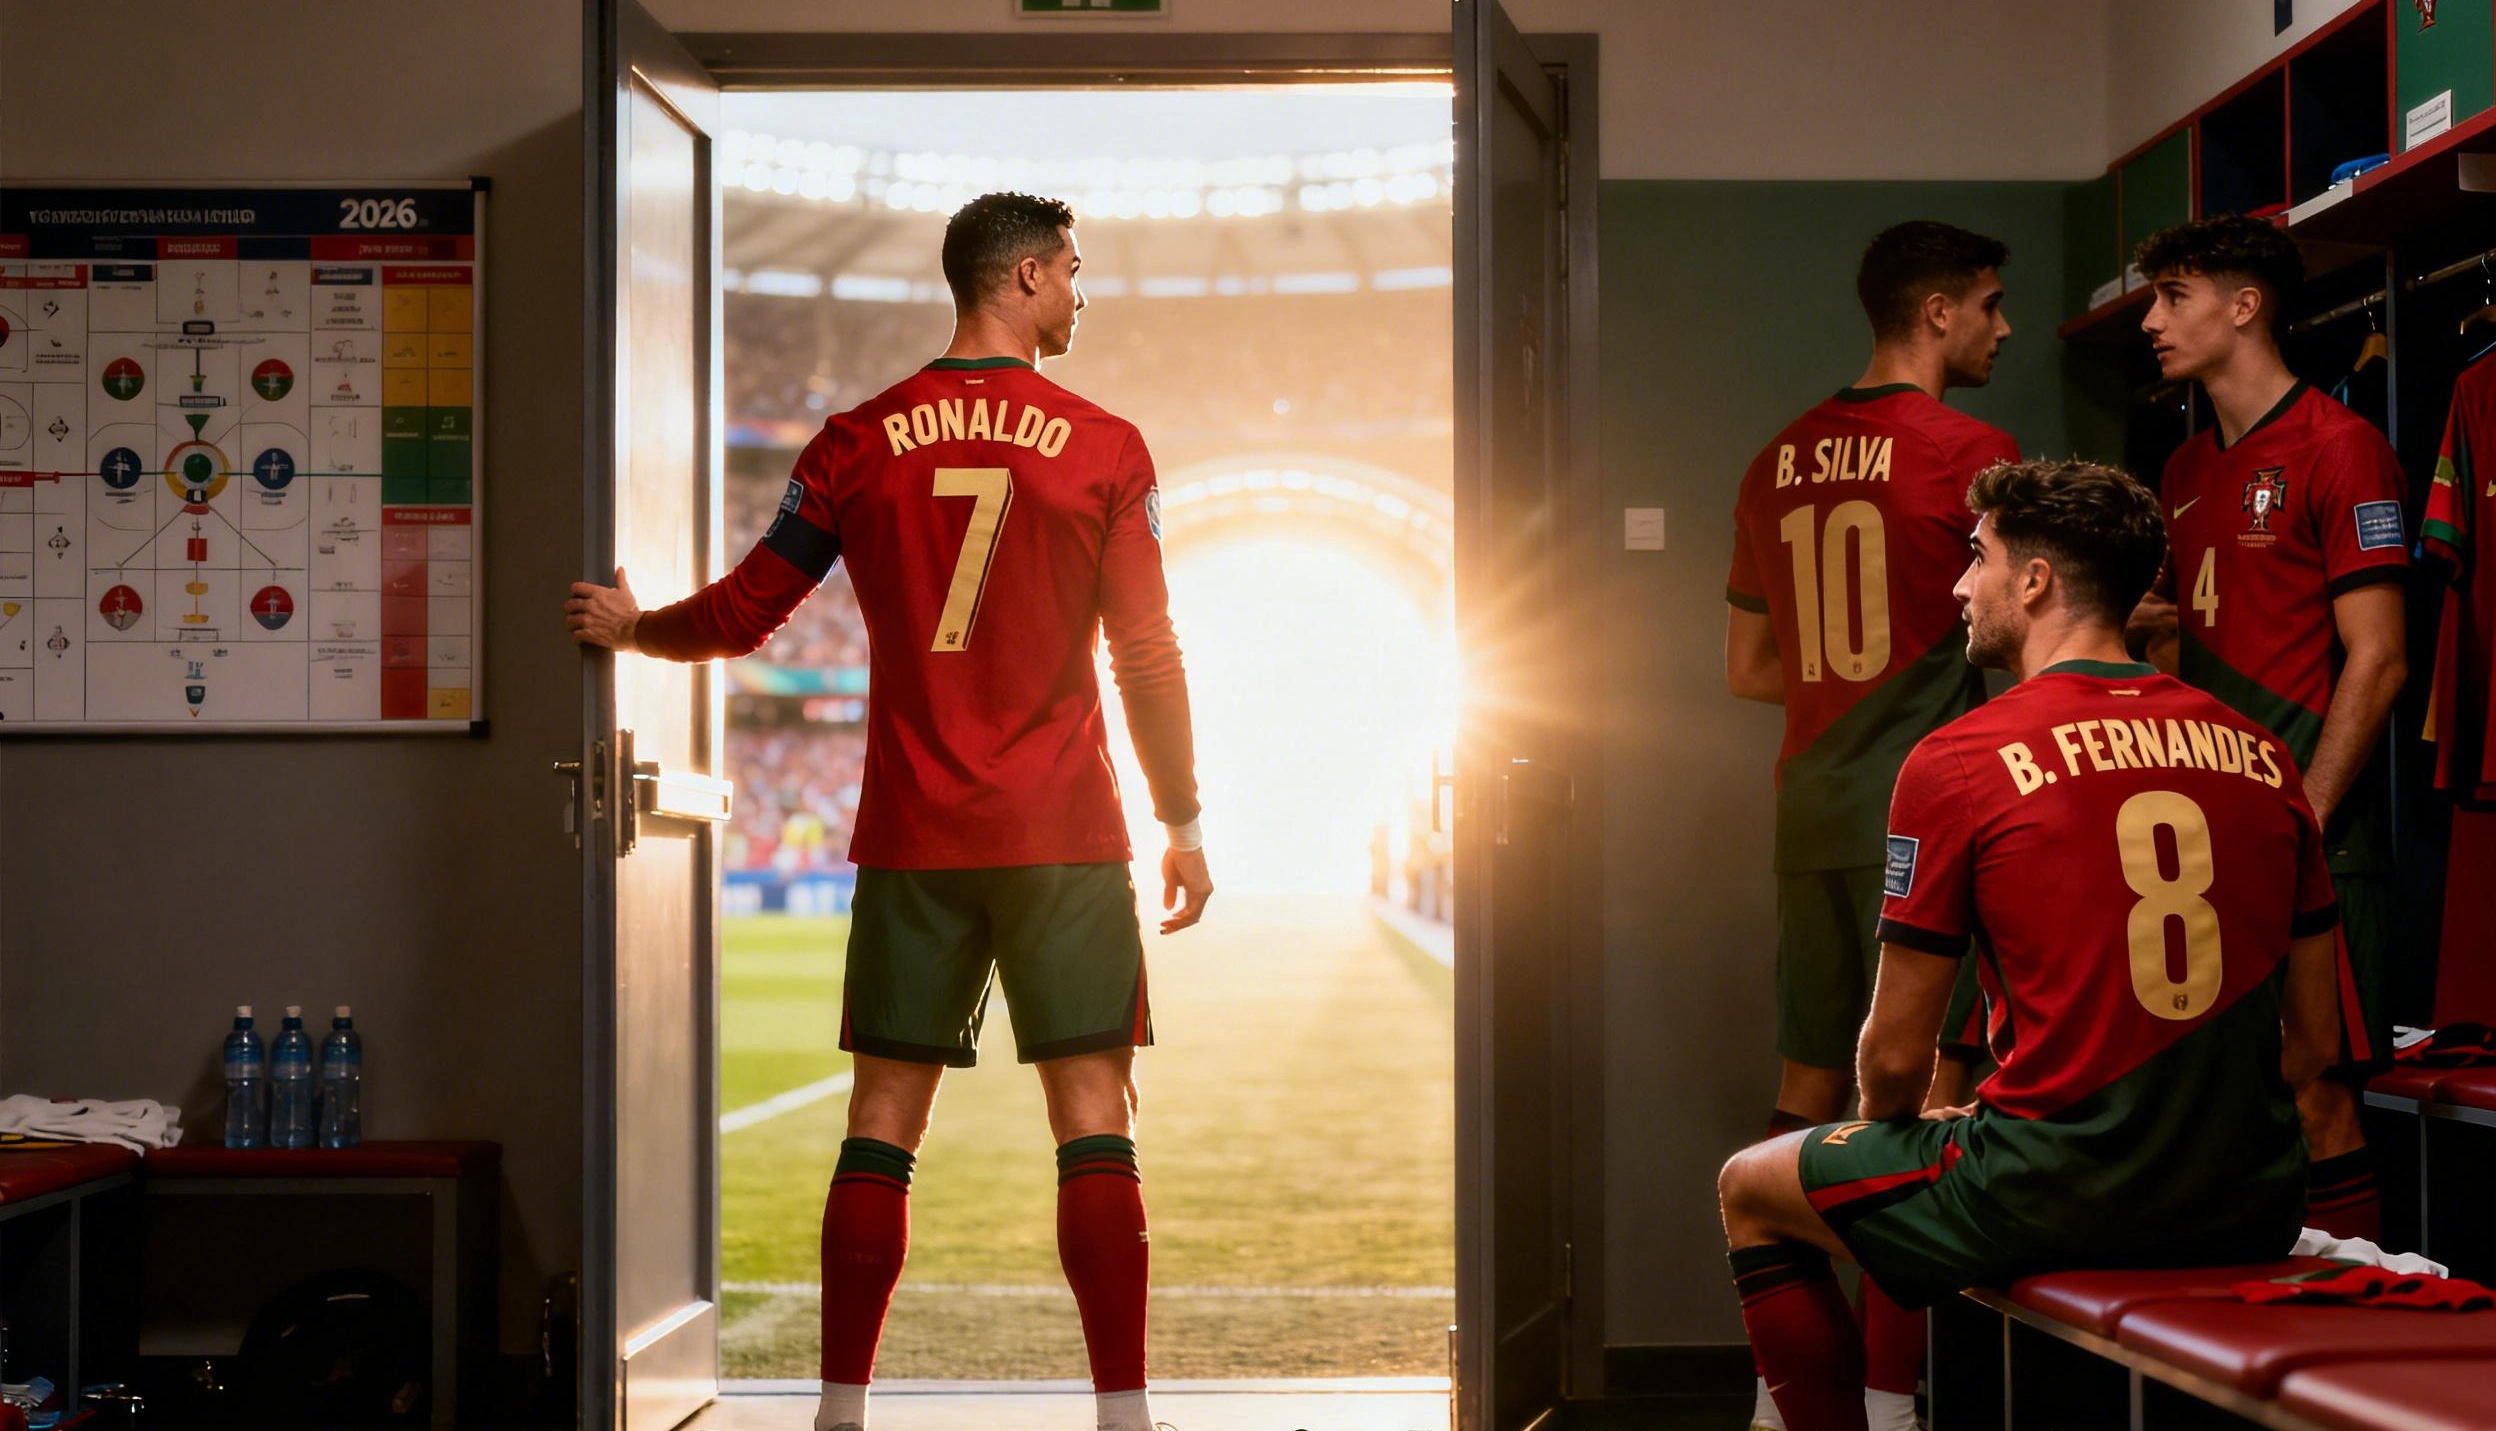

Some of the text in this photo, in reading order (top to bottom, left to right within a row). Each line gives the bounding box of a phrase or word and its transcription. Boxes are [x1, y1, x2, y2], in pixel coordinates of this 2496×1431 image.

[339, 198, 418, 229] 2026
[883, 398, 1072, 458] RONALDO
[1776, 436, 1893, 489] B. SILVA
[931, 467, 1014, 652] 7
[1780, 500, 1891, 682] 10
[2192, 546, 2219, 627] 4
[1997, 717, 2283, 796] B. FERNANDES
[2115, 790, 2223, 1021] 8
